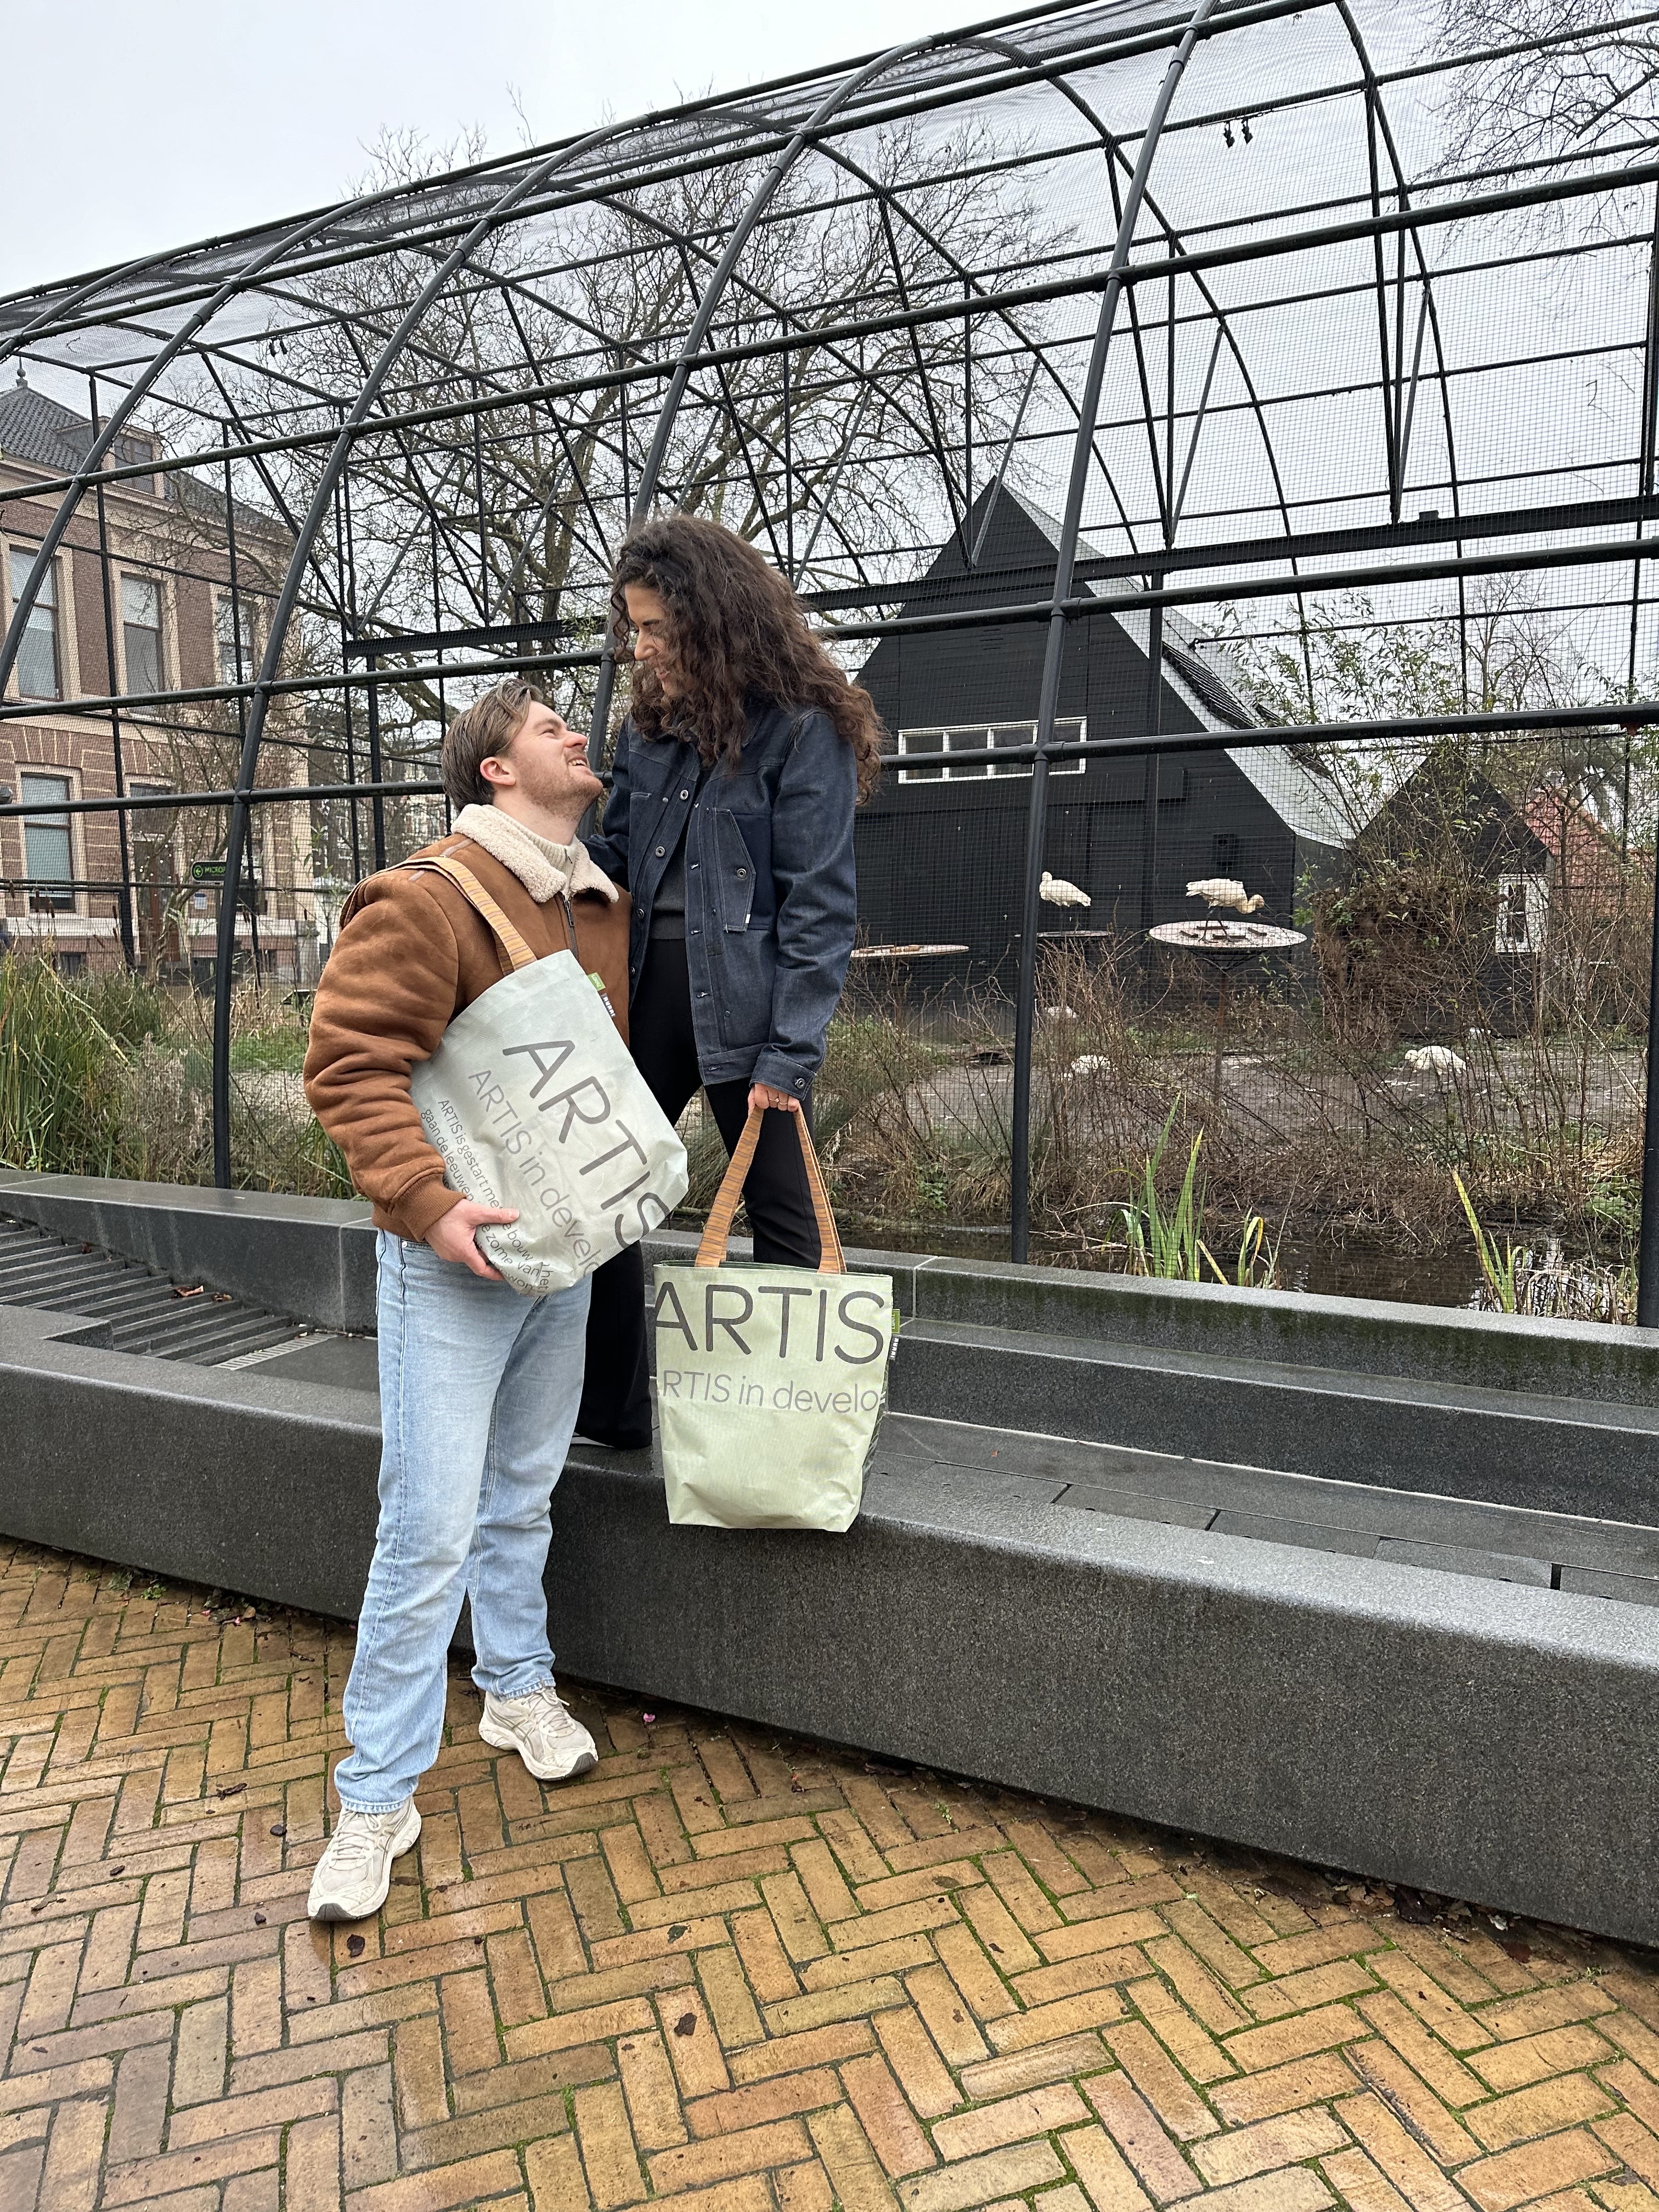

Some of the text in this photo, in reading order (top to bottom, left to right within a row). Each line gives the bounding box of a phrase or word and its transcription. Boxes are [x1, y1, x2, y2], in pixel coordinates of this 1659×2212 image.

[438, 1100, 462, 1134] ARTIS
[468, 1070, 532, 1154] ARTIS
[519, 1151, 545, 1187] in
[455, 1133, 466, 1145] is
[502, 1040, 670, 1249] ARTIS
[457, 1145, 488, 1187] gestart
[421, 1109, 441, 1137] gaan
[437, 1137, 448, 1153] de
[517, 1262, 540, 1278] van
[482, 1187, 503, 1209] me
[507, 1229, 534, 1261] bouw
[655, 1281, 884, 1364] ARTIS
[659, 1370, 878, 1414] RTIS in develo
